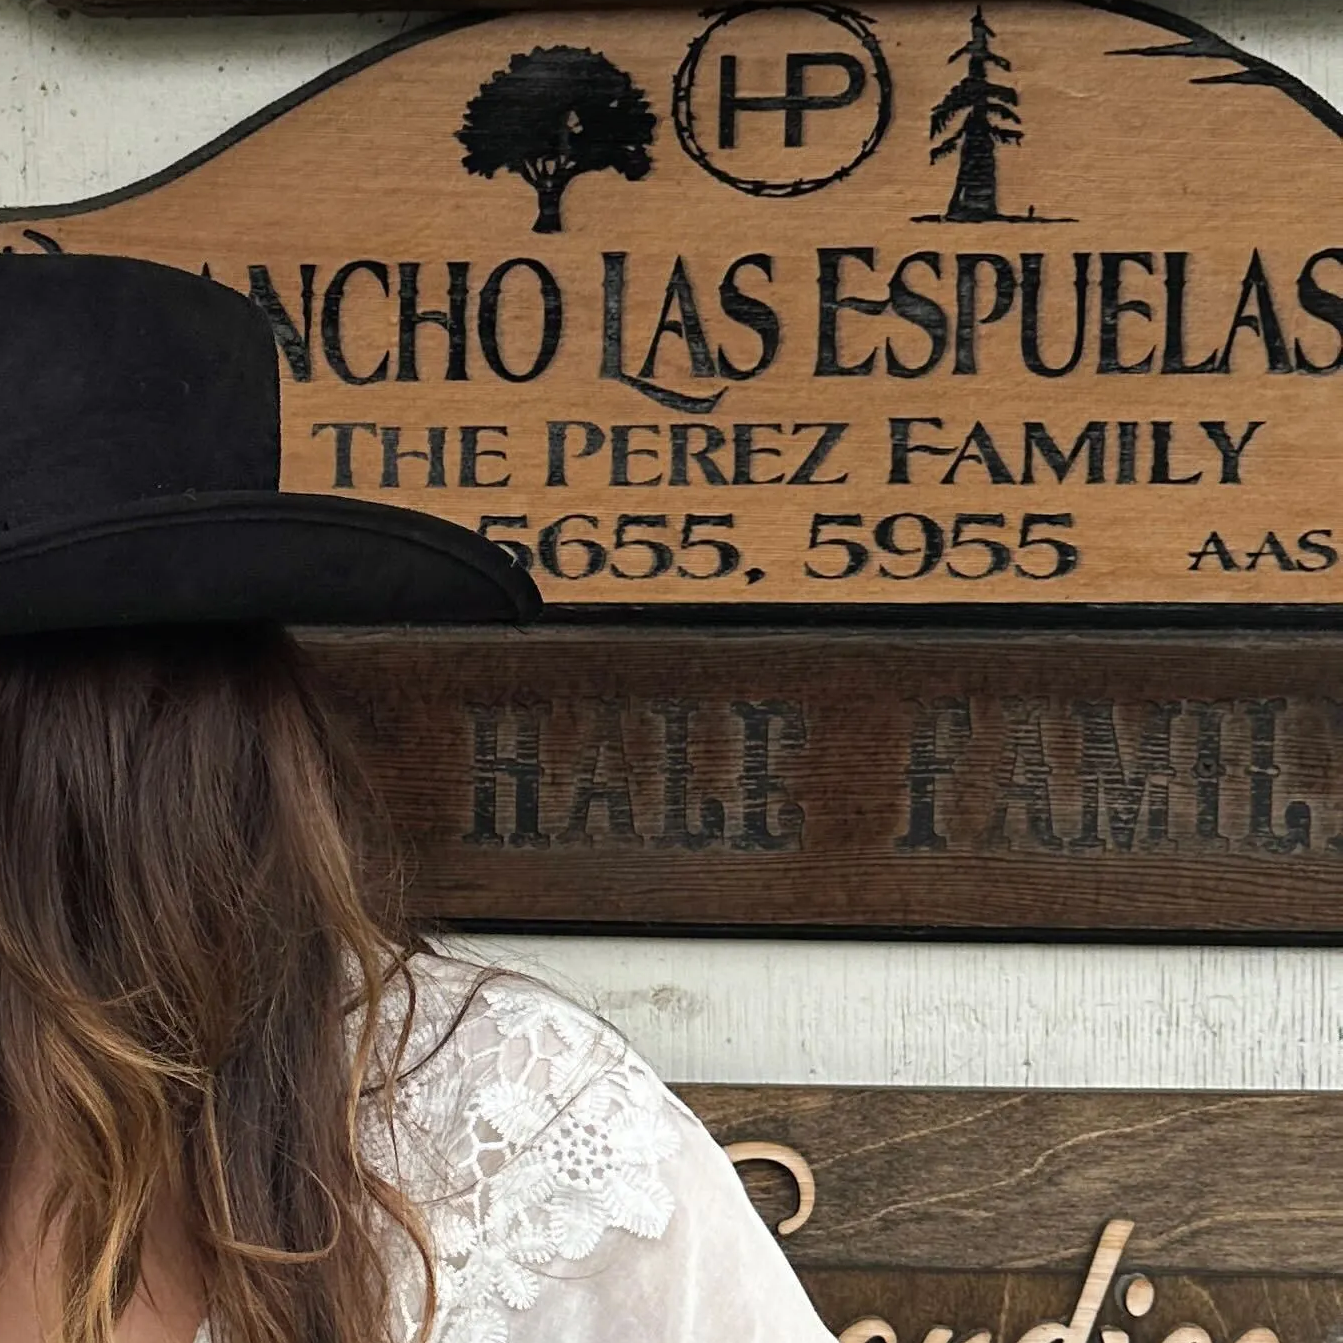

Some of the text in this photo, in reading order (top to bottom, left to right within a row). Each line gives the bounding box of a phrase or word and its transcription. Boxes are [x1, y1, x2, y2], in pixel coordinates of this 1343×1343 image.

[200, 257, 560, 385] NCHO
[312, 419, 1266, 489] THE PEREZ FAMILY
[807, 512, 1079, 581] 5955
[463, 695, 807, 852] HALE
